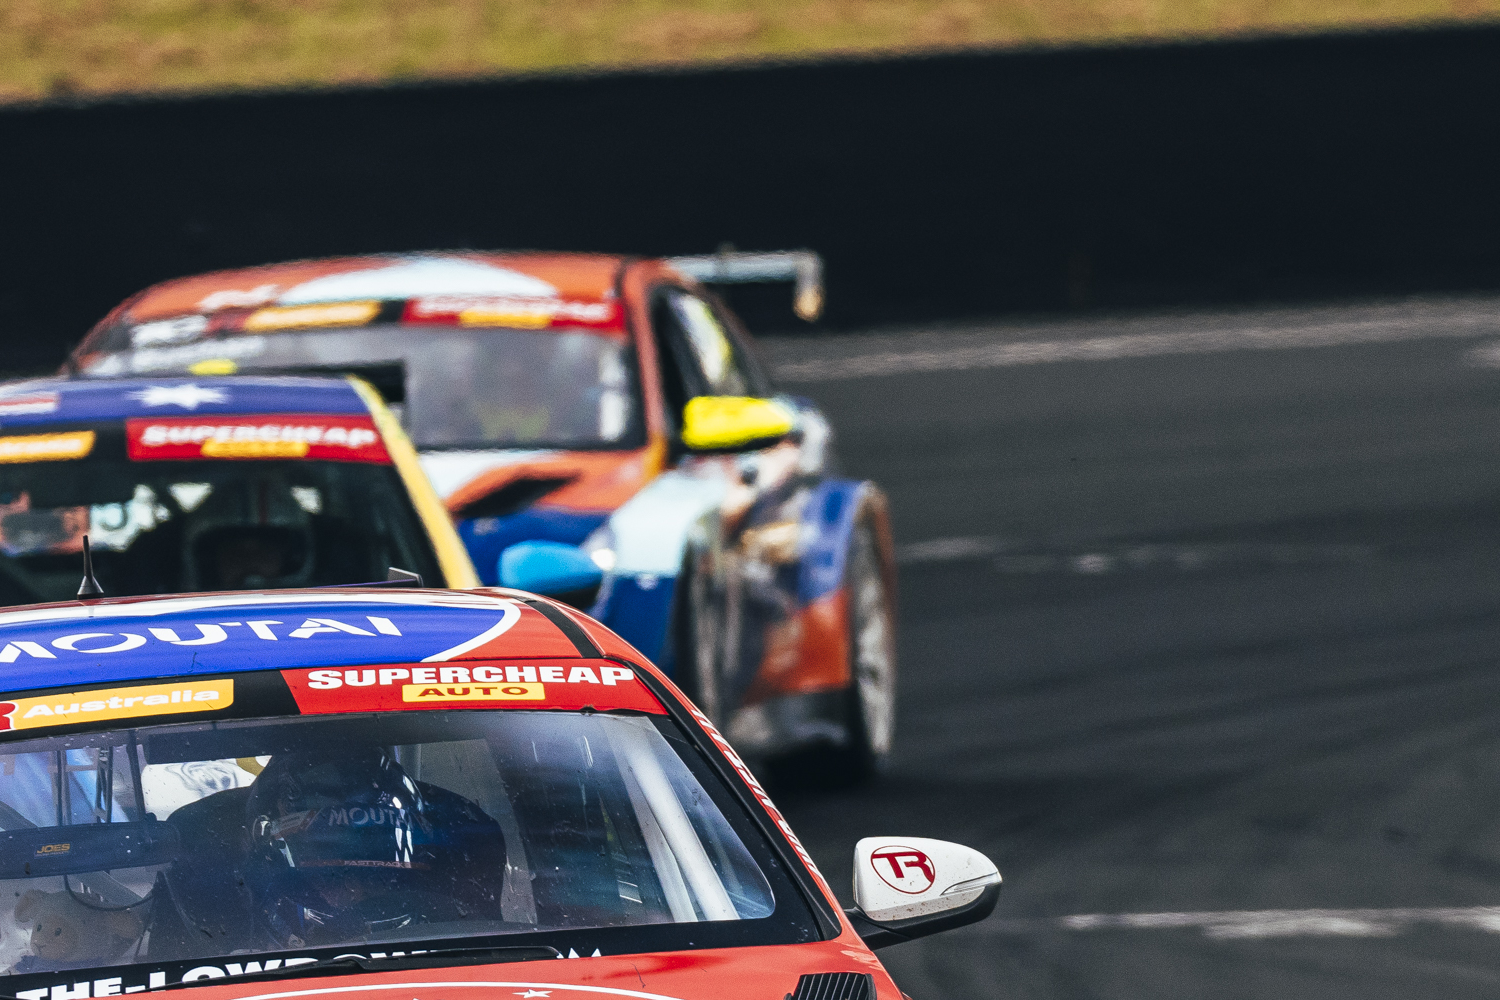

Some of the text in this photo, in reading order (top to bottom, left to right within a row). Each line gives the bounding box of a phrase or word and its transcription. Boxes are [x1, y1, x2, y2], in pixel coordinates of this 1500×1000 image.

[307, 665, 635, 691] SUPERCHEAP
[22, 687, 220, 719] Australia
[415, 686, 527, 699] AUTO
